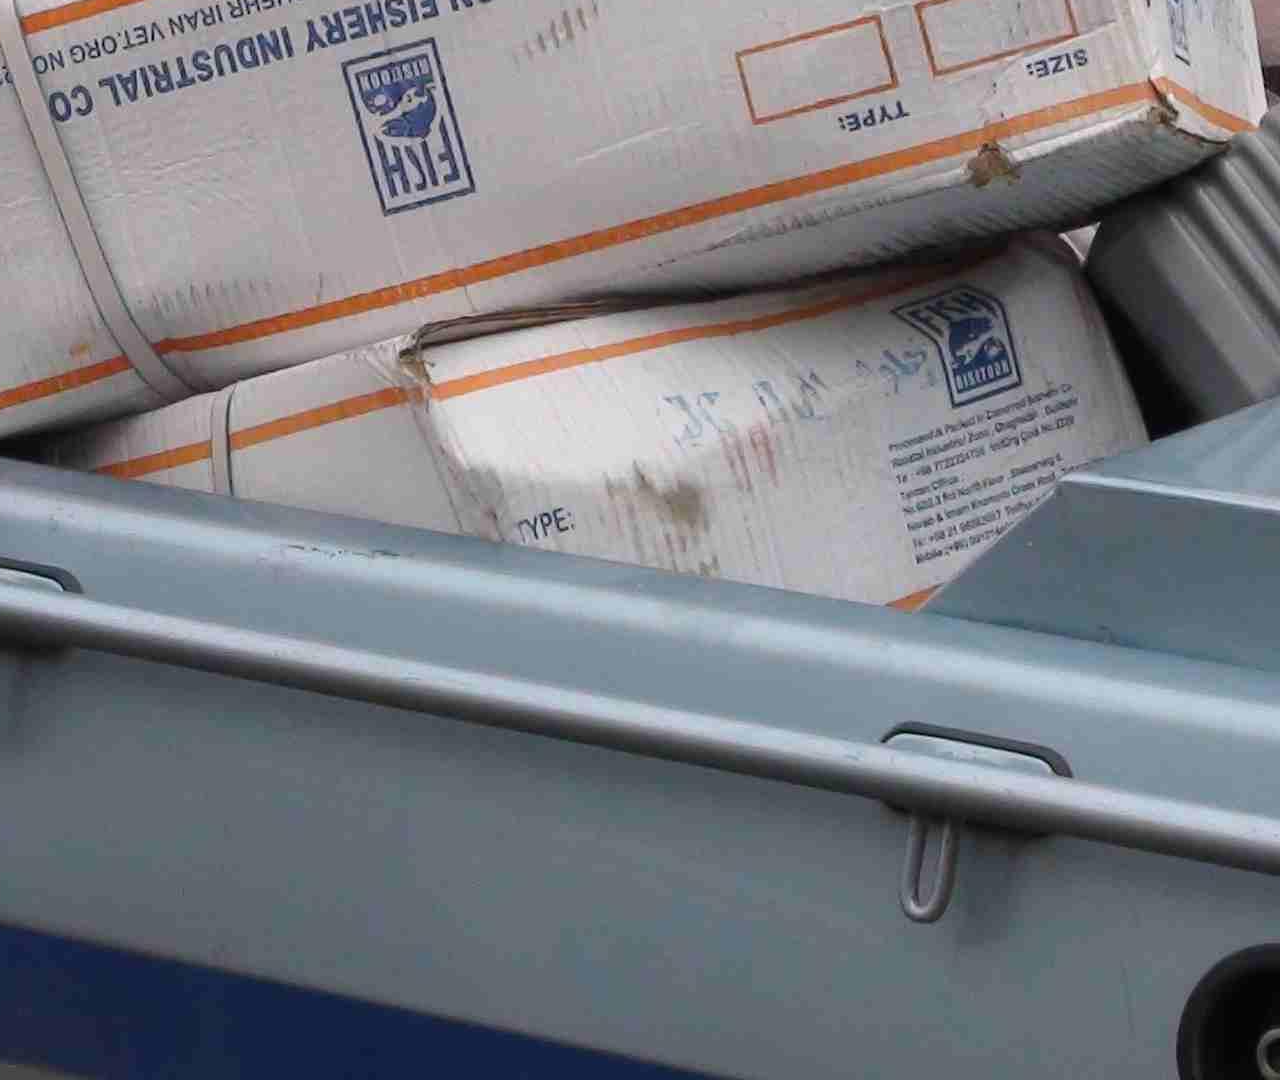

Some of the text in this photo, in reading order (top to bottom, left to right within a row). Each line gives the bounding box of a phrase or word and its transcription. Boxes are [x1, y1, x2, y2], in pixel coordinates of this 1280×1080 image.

[170, 5, 222, 37] IRAN
[98, 26, 293, 107] INDUSTRIAL
[1026, 49, 1089, 78] SIZE:
[48, 84, 94, 122] CO
[837, 100, 910, 132] TYPE:
[374, 116, 461, 198] FISH
[517, 507, 575, 544] TYPE:
